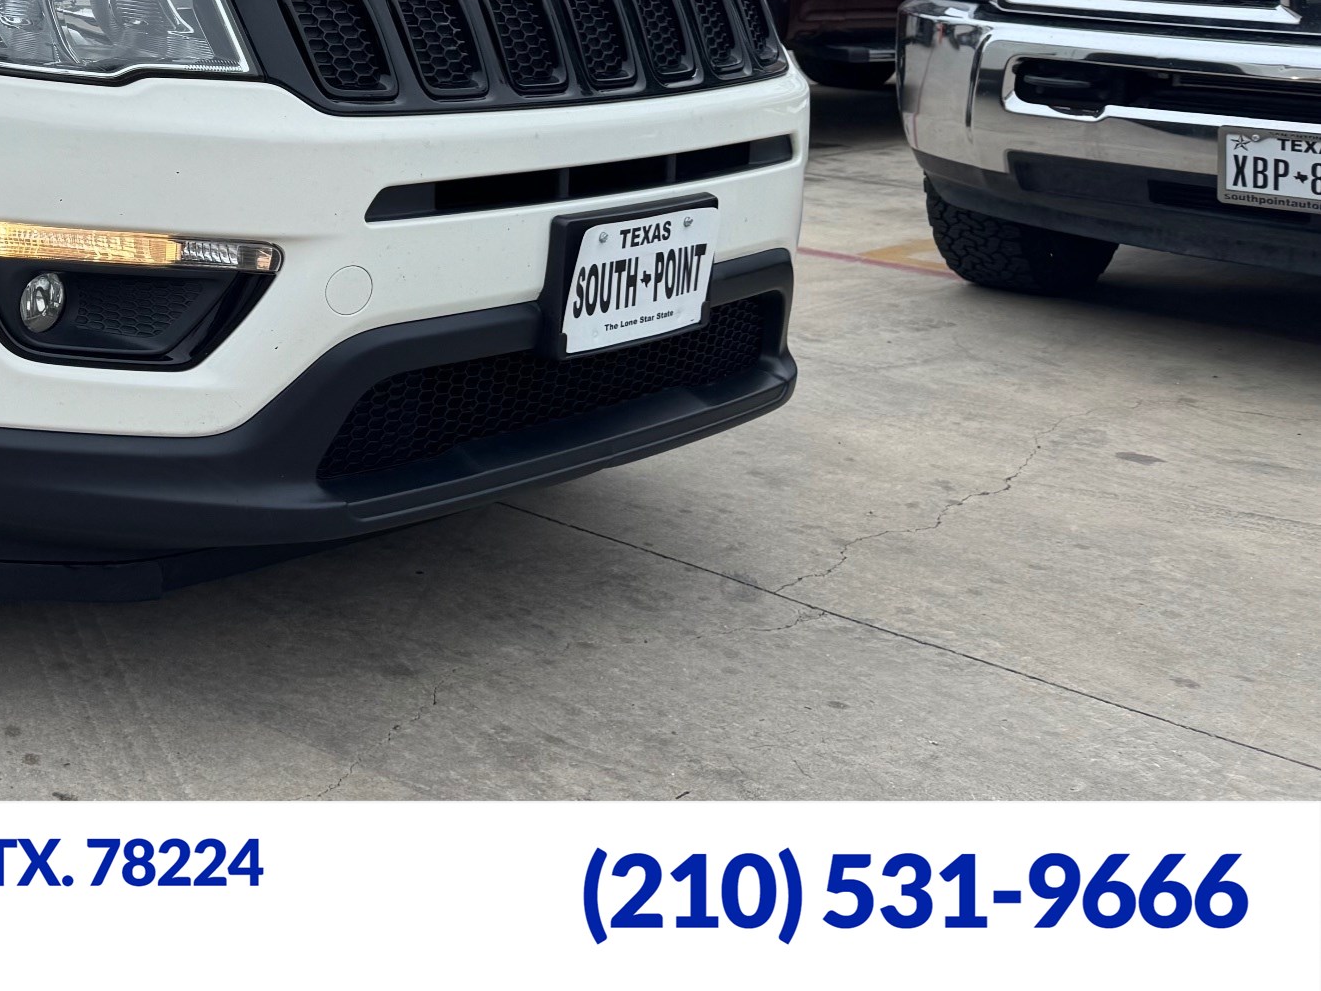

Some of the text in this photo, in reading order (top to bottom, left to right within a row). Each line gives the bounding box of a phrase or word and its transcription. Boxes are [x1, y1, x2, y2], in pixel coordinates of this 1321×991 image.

[619, 220, 672, 249] TEXAS
[604, 309, 674, 332] The Lone Star State
